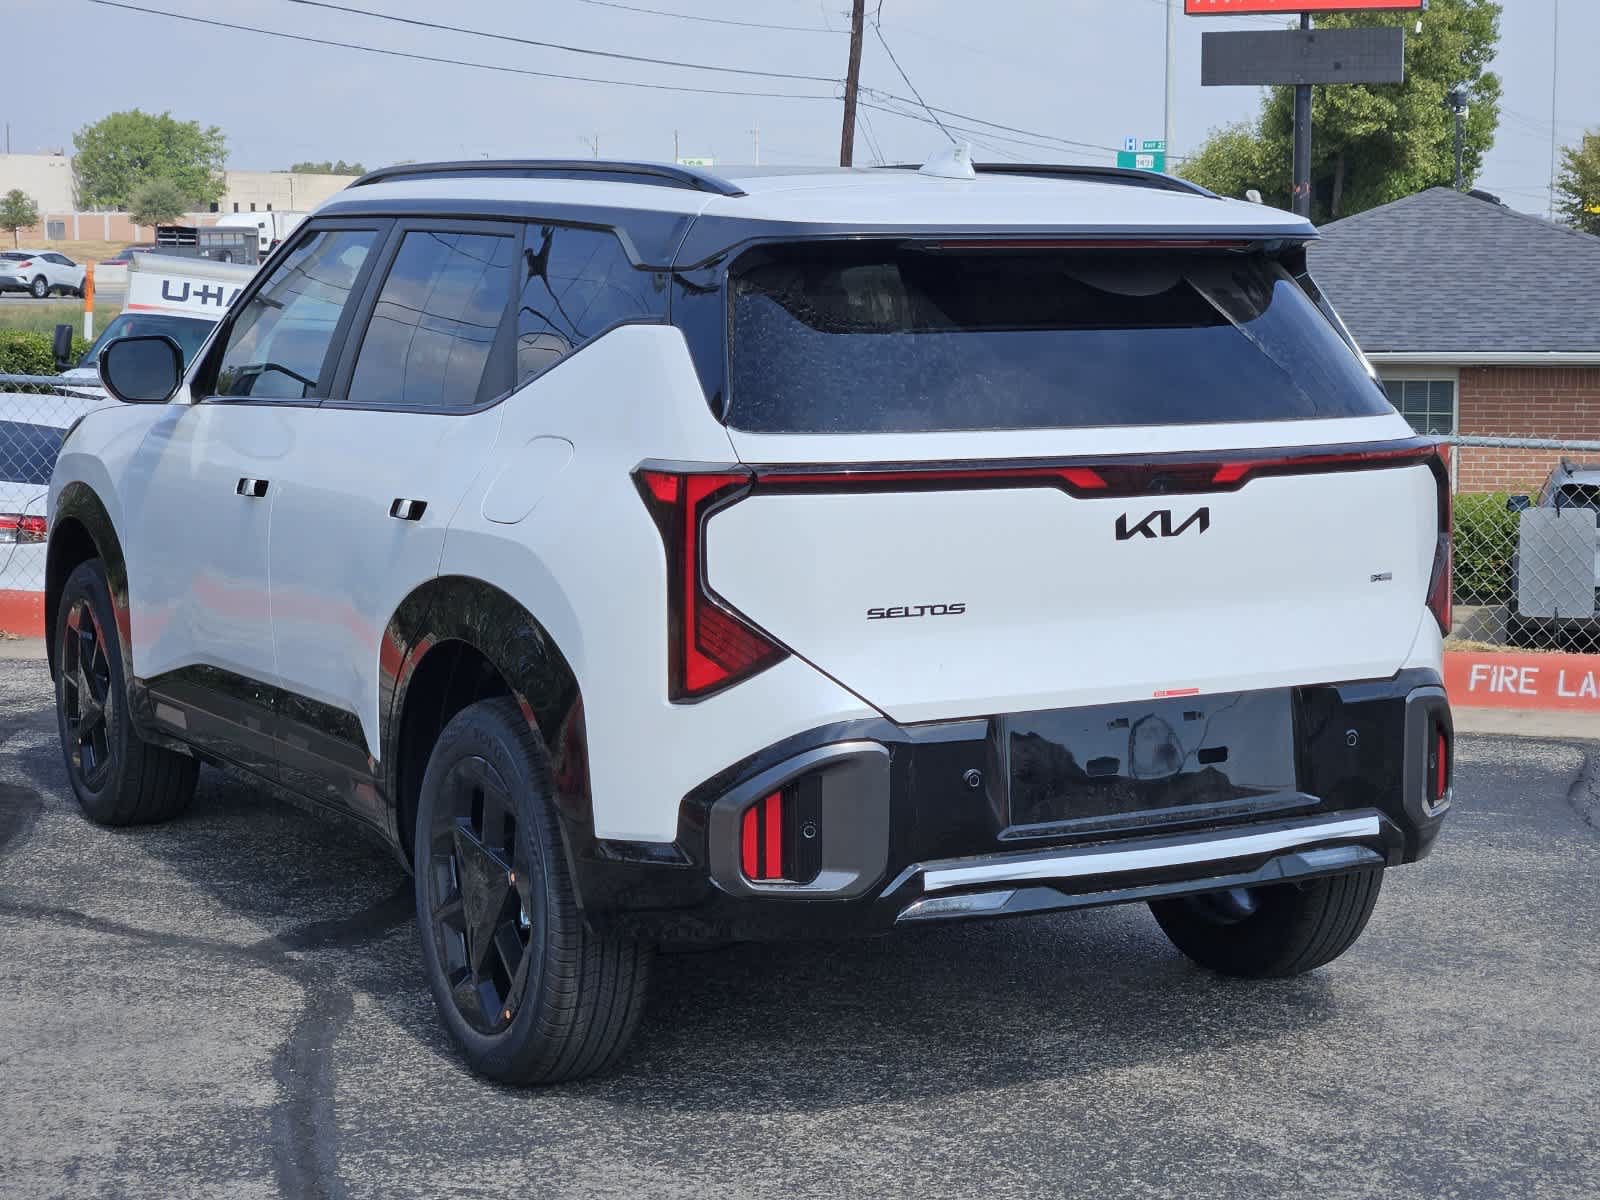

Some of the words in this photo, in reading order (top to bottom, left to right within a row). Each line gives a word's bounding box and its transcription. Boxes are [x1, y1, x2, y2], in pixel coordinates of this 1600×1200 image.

[1115, 506, 1210, 541] KIA
[866, 602, 966, 620] SELTOS
[1468, 663, 1540, 695] FIRE
[1557, 669, 1600, 699] LA
